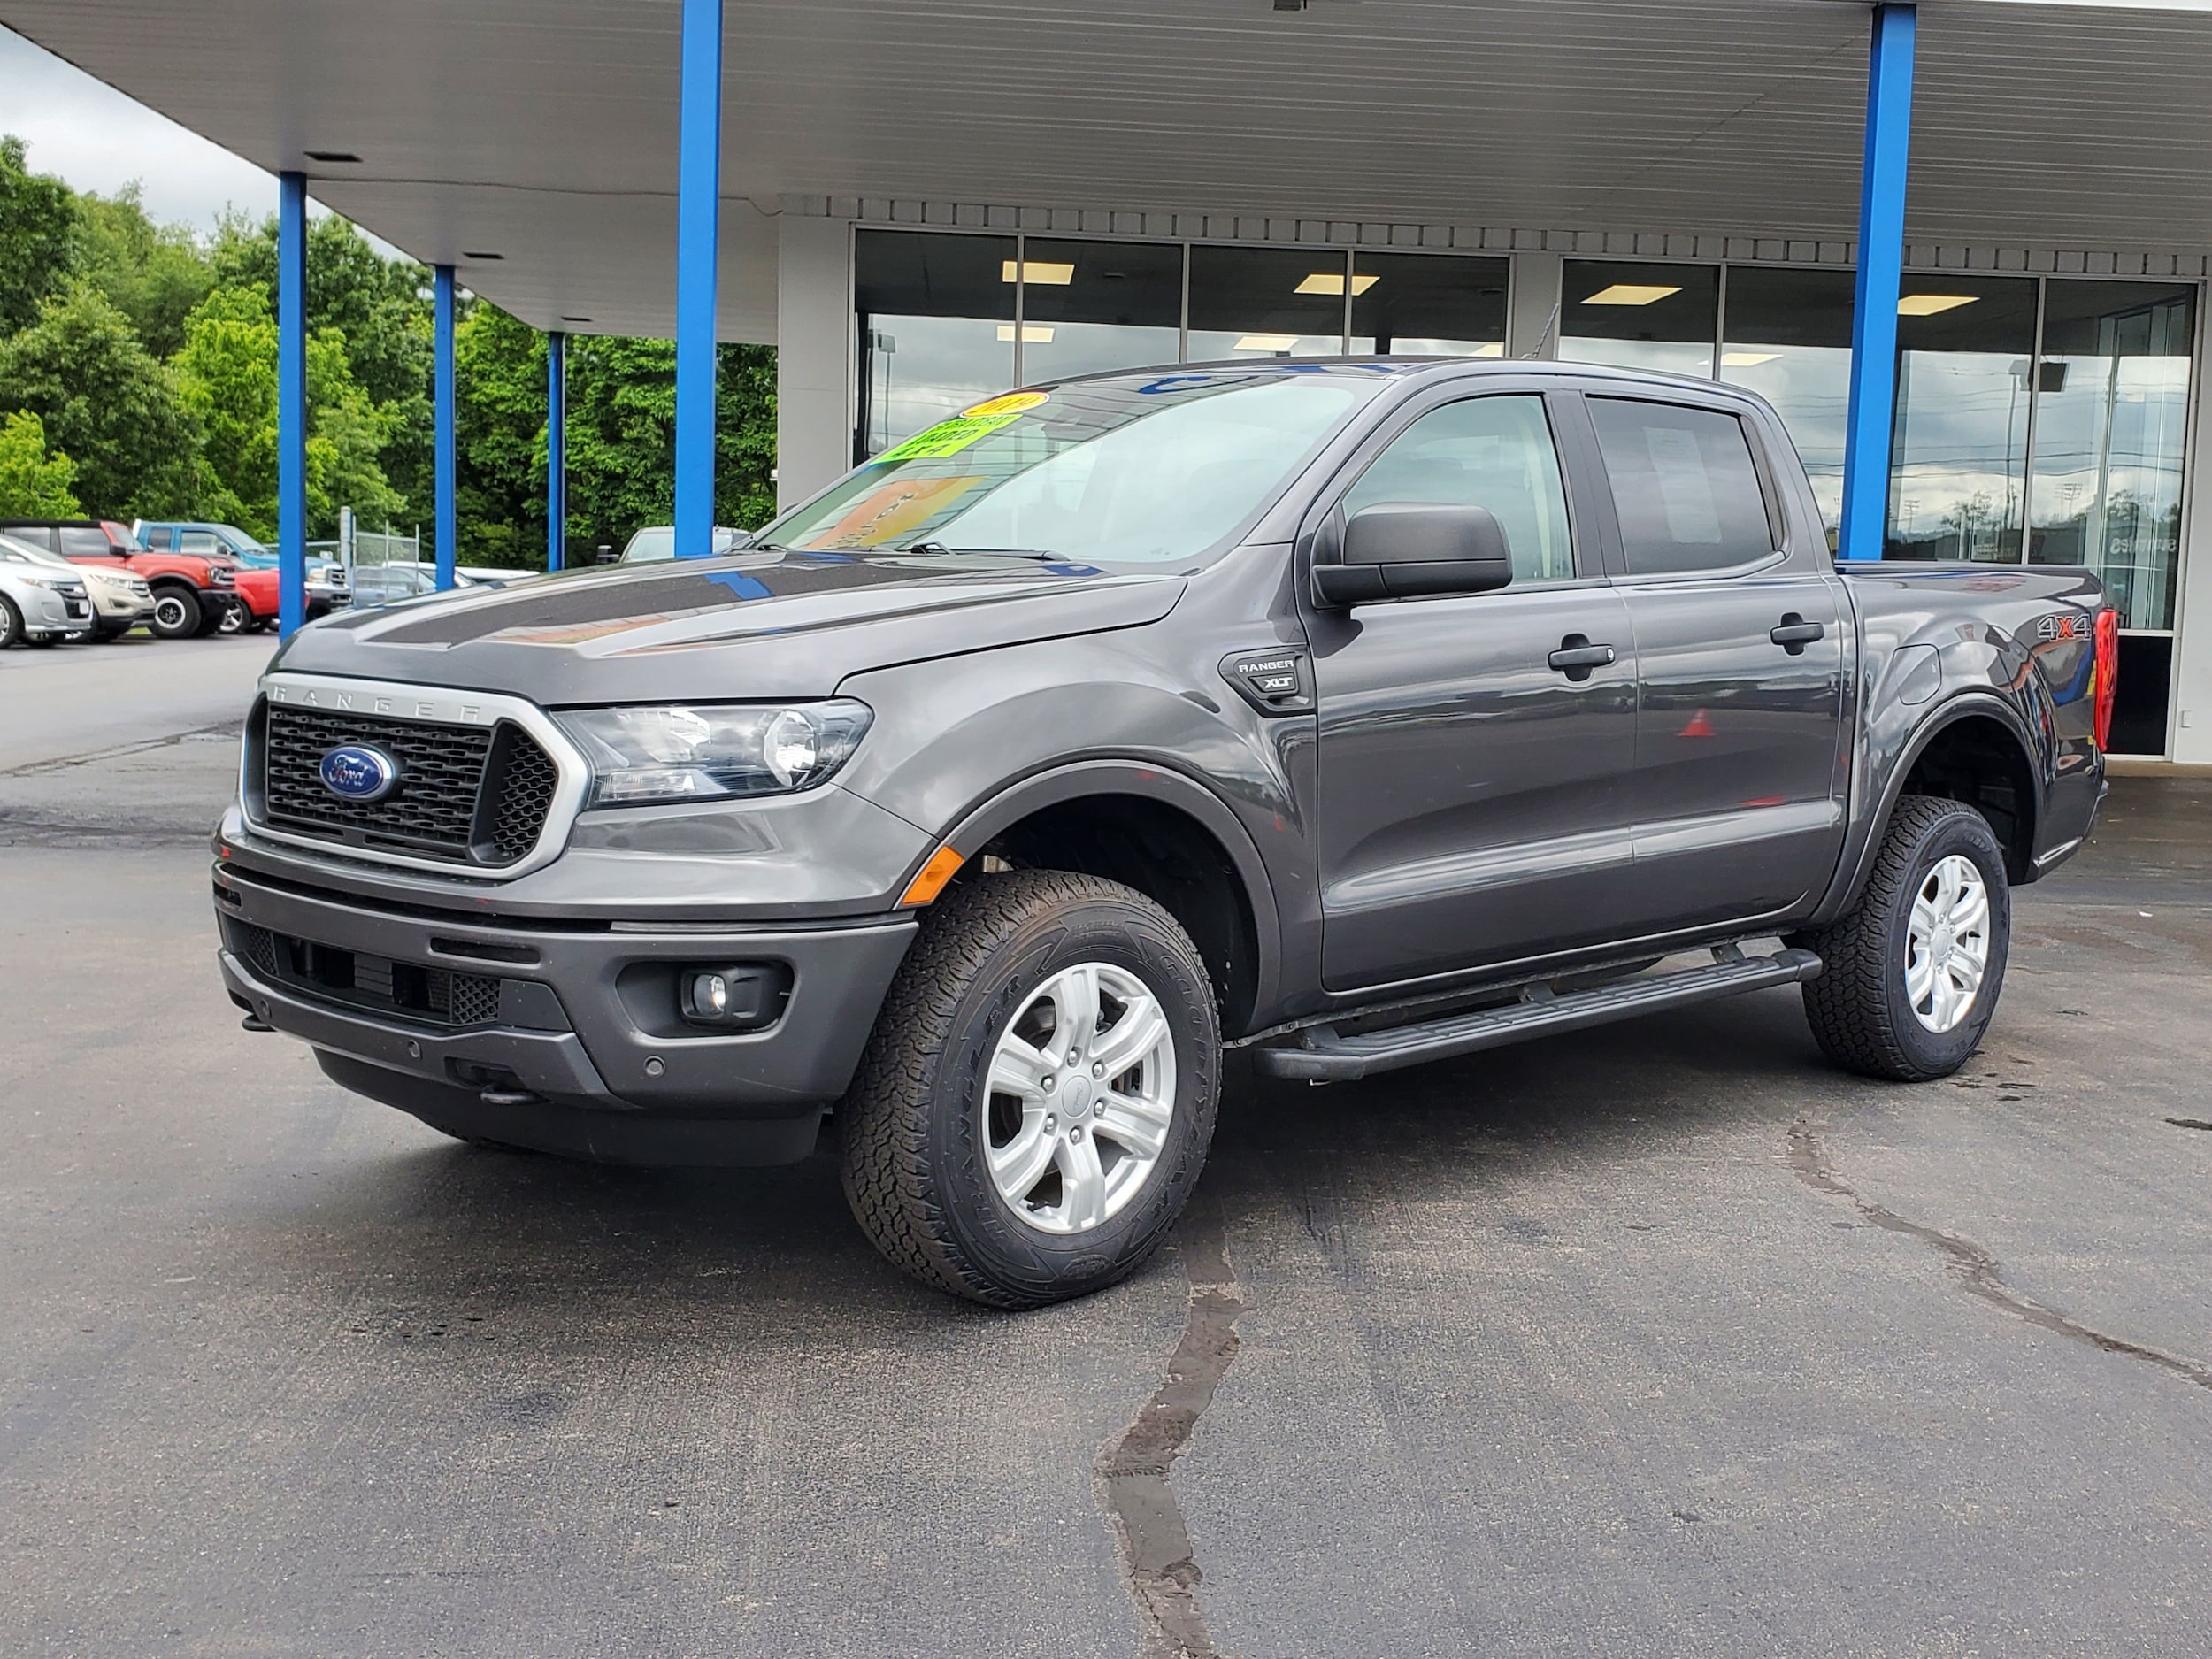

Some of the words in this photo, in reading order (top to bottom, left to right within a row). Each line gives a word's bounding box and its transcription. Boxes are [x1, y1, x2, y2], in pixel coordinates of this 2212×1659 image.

[1239, 660, 1294, 672] RANGER
[1263, 677, 1293, 688] XLT
[273, 686, 480, 722] RANGER
[328, 754, 369, 787] Ford
